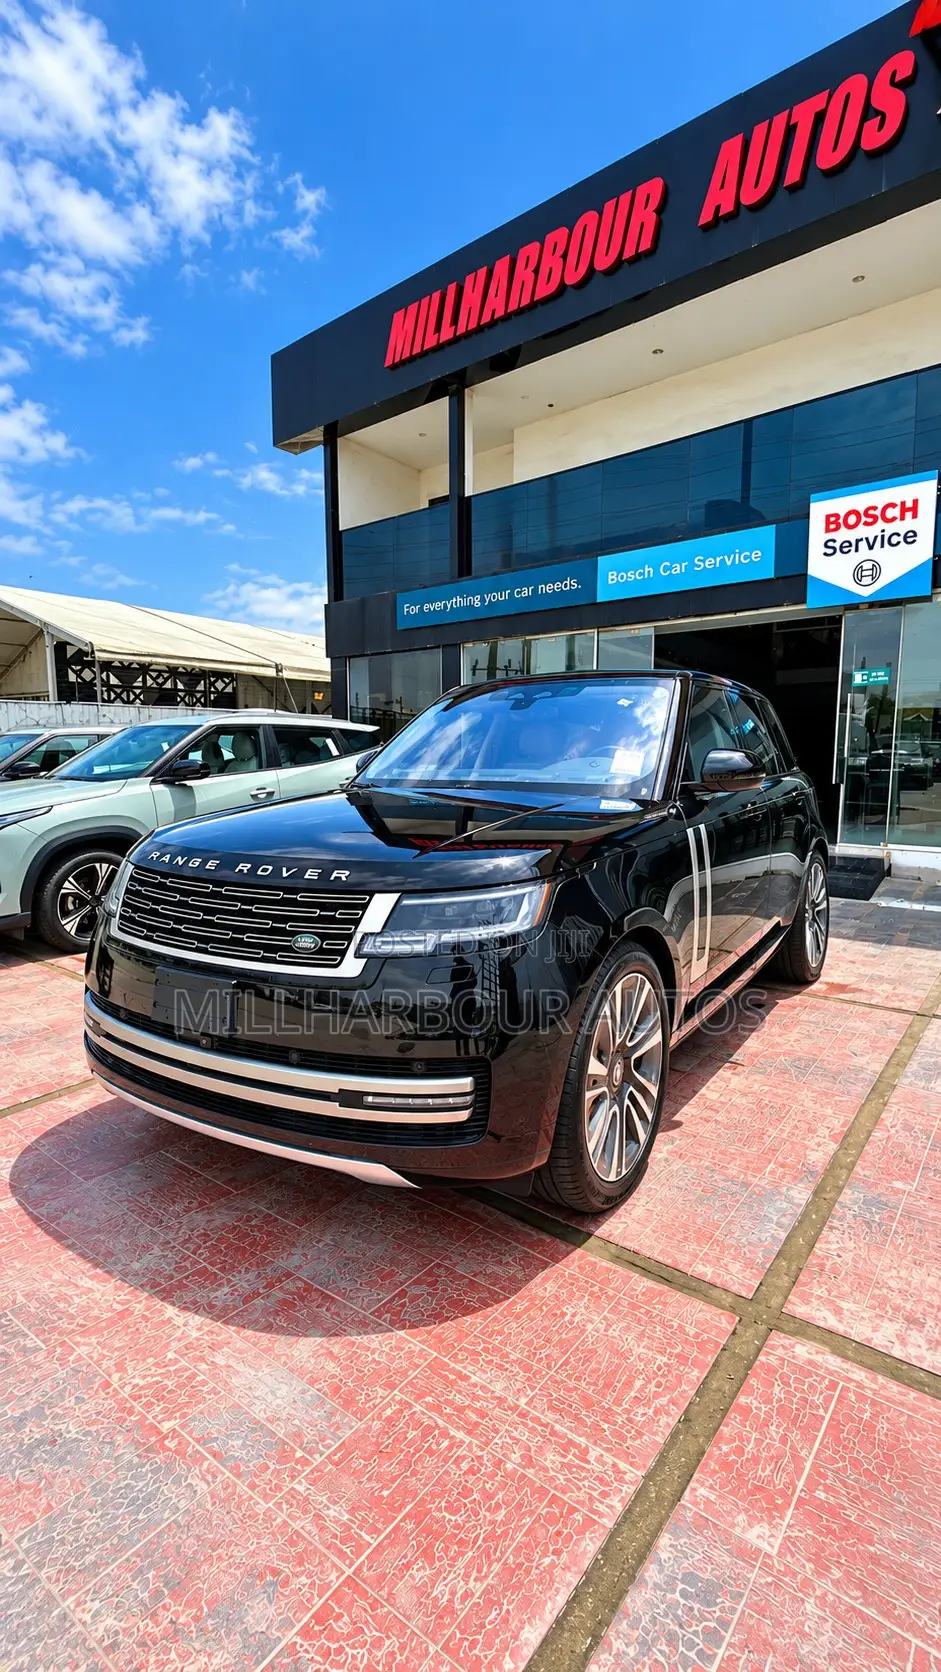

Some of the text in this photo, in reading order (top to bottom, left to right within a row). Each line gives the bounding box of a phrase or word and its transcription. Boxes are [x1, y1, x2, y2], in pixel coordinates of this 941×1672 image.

[384, 49, 917, 369] MILLHARBOUR AUTOS
[824, 498, 919, 534] BOSCH
[823, 528, 918, 557] Service
[607, 549, 763, 585] Bosch Car Service
[403, 577, 582, 616] For everything your car needs.
[148, 851, 351, 882] RANGE ROVER
